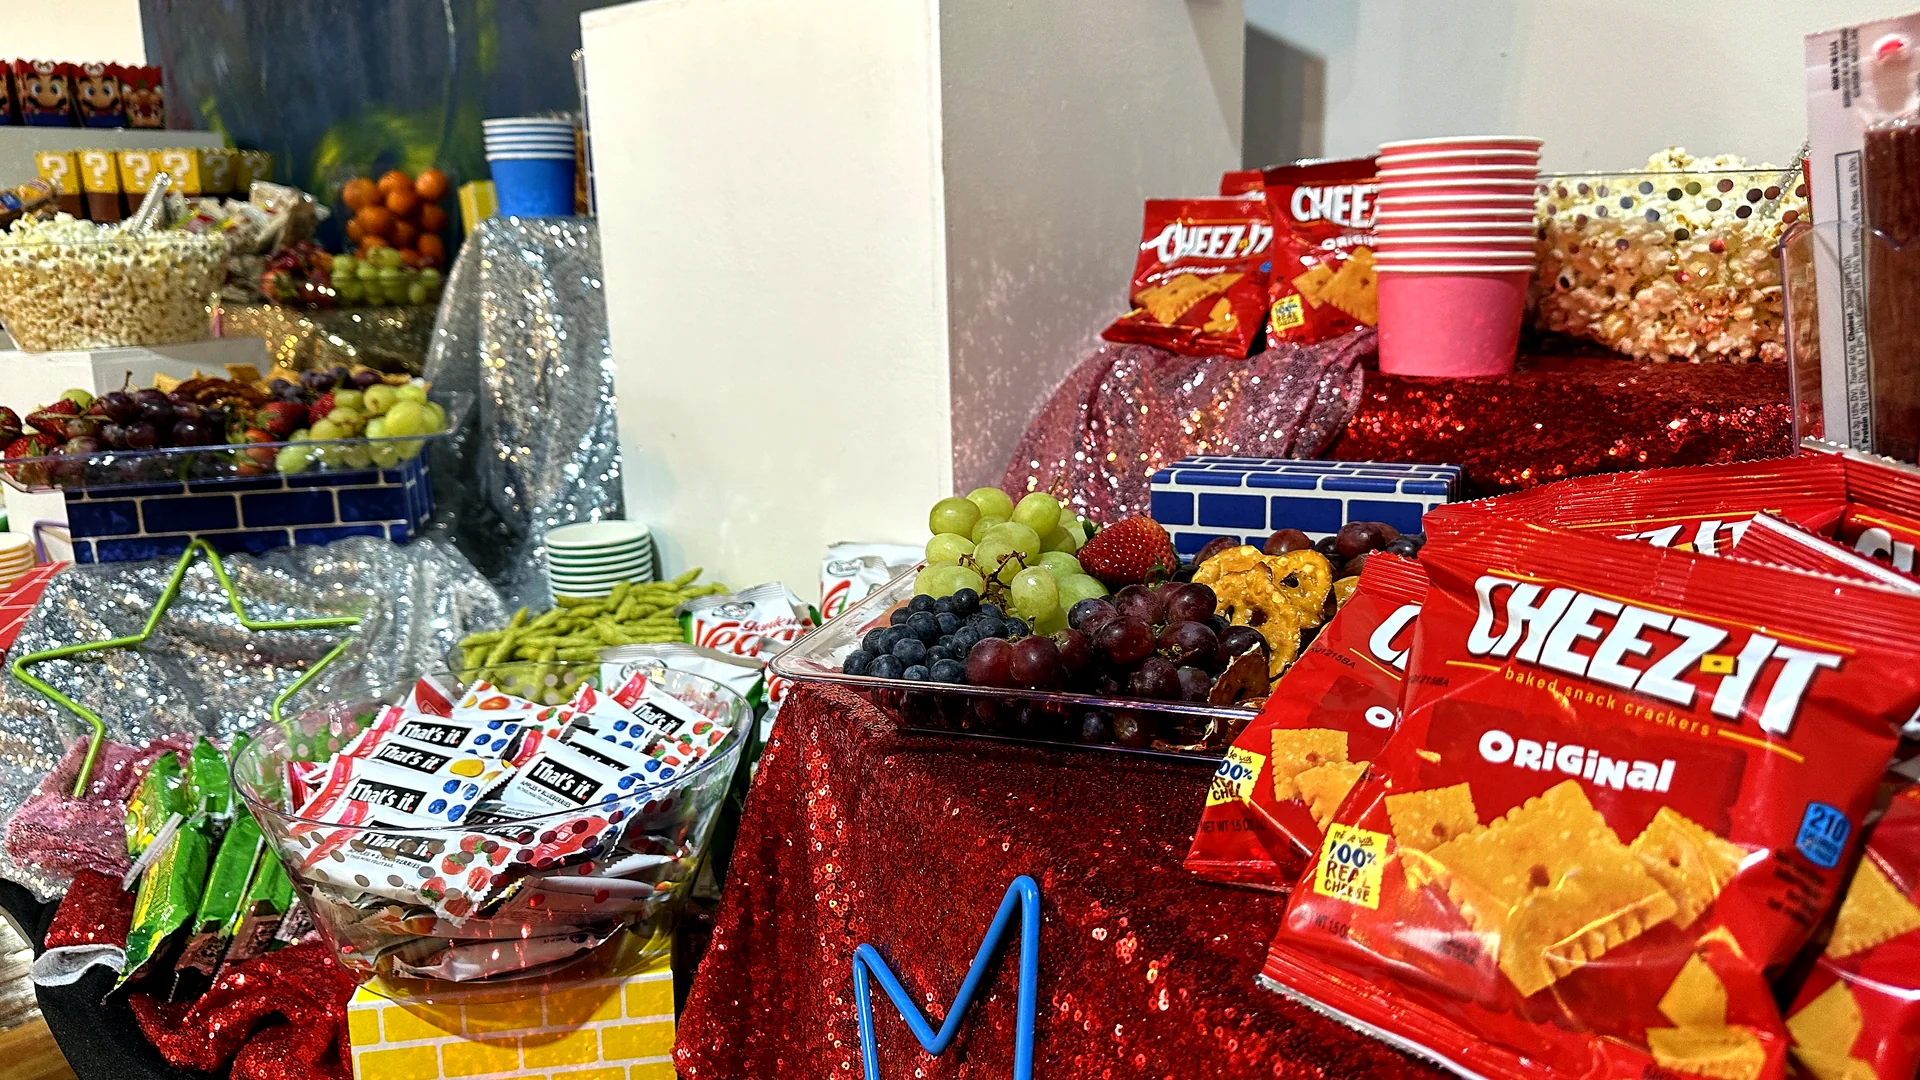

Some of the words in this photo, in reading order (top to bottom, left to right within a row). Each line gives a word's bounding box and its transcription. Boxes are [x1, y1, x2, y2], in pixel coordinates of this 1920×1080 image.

[1504, 666, 1558, 692] baked
[1564, 684, 1616, 709] snack
[1624, 700, 1710, 737] crackers
[400, 723, 445, 742] That's
[379, 745, 422, 766] That's
[533, 760, 576, 791] That's
[1217, 759, 1253, 780] 00%
[350, 783, 399, 808] That's
[1809, 805, 1849, 843] 210
